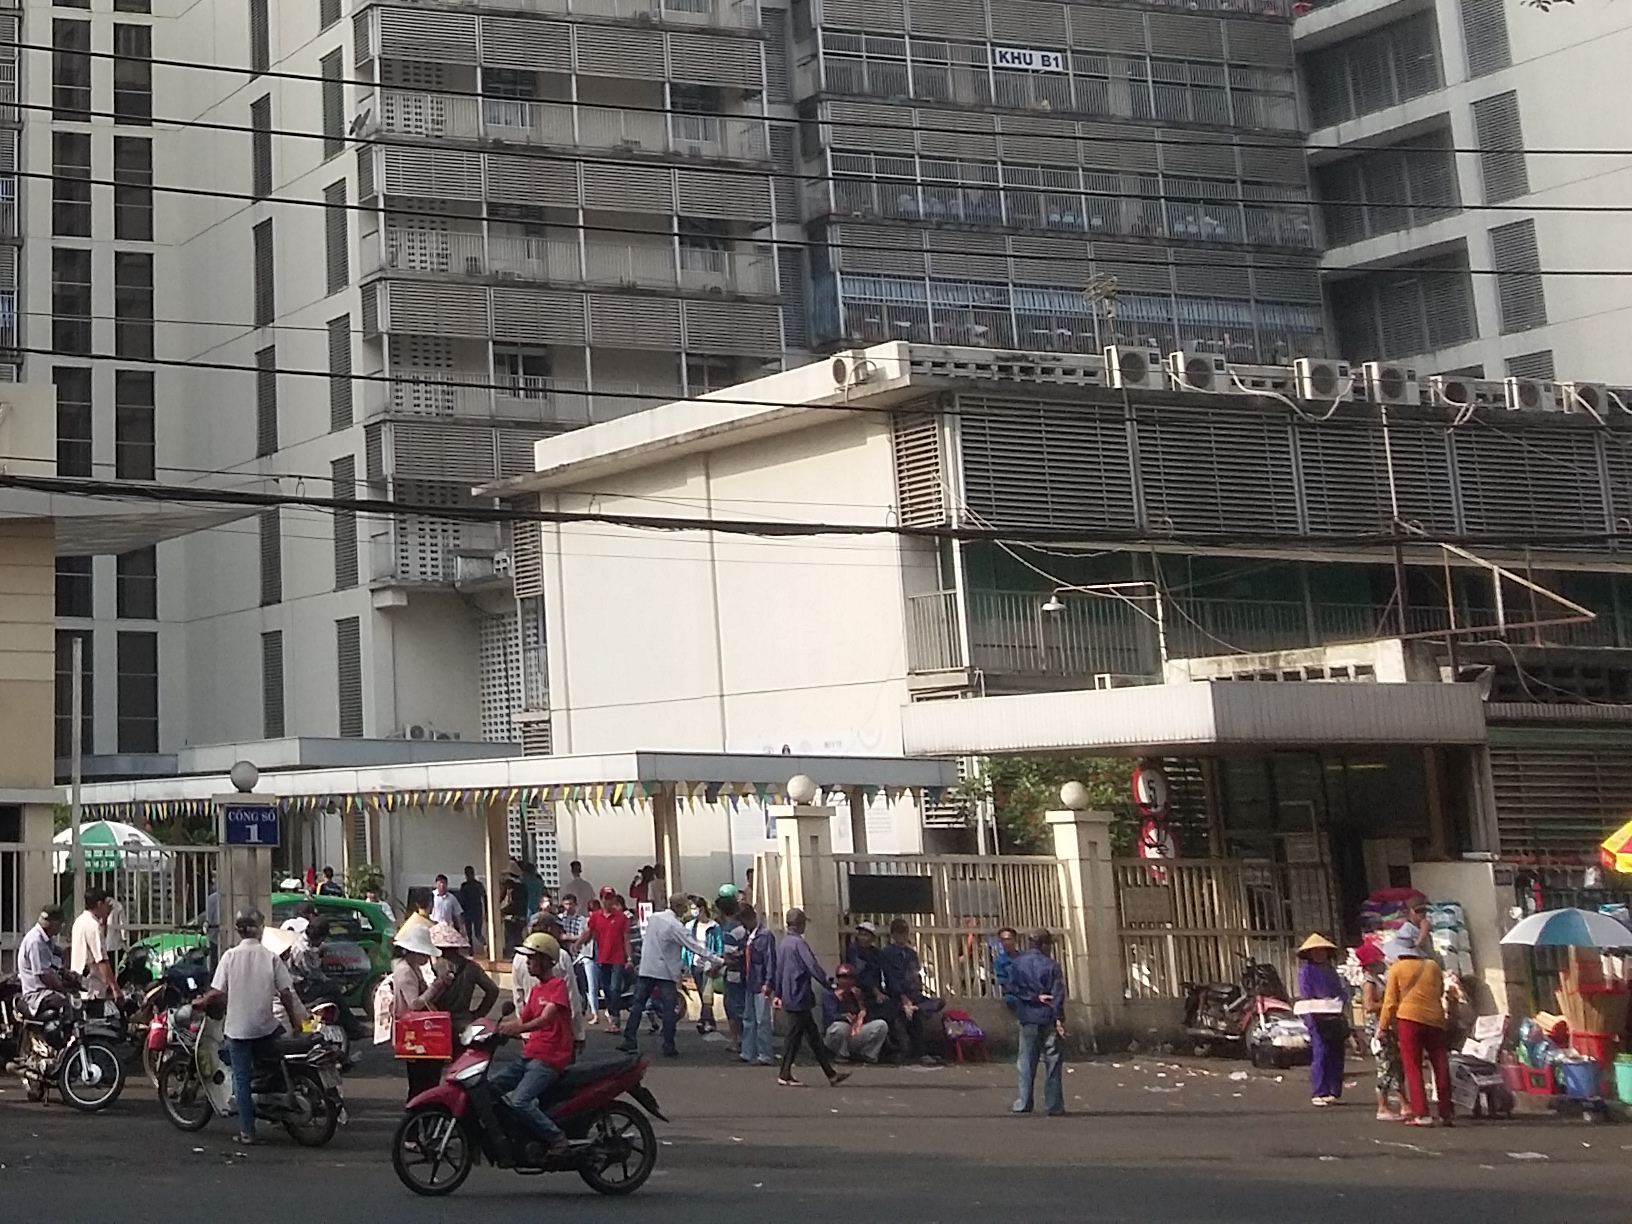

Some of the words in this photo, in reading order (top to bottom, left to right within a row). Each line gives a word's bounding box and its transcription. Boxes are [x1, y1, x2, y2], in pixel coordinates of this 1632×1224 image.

[998, 50, 1033, 66] KHU
[1041, 54, 1060, 68] B1
[245, 823, 263, 843] 1
